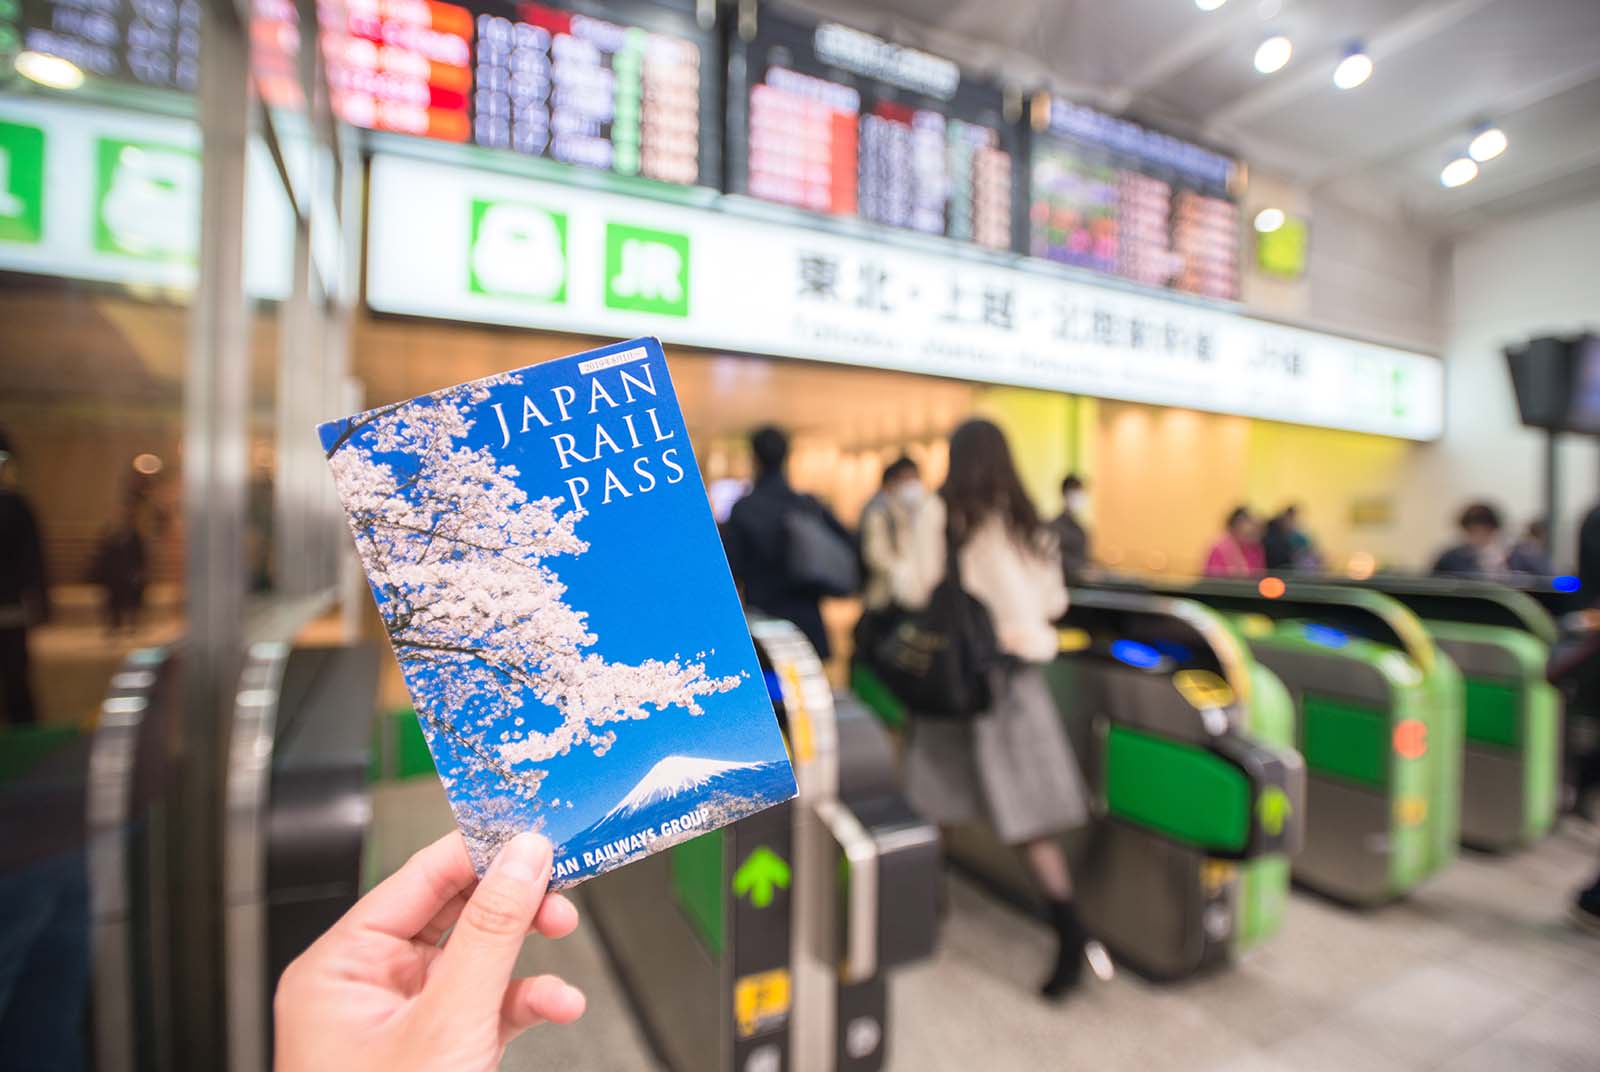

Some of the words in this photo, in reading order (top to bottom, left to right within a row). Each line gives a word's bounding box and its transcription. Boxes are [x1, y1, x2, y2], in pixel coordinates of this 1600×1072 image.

[610, 238, 682, 304] JR
[490, 363, 657, 449] JAPAN
[550, 408, 675, 470] RAIL
[564, 448, 685, 512] PASS
[551, 856, 580, 880] PAN
[583, 828, 658, 868] RAILWAYS
[660, 807, 710, 837] GROUP
